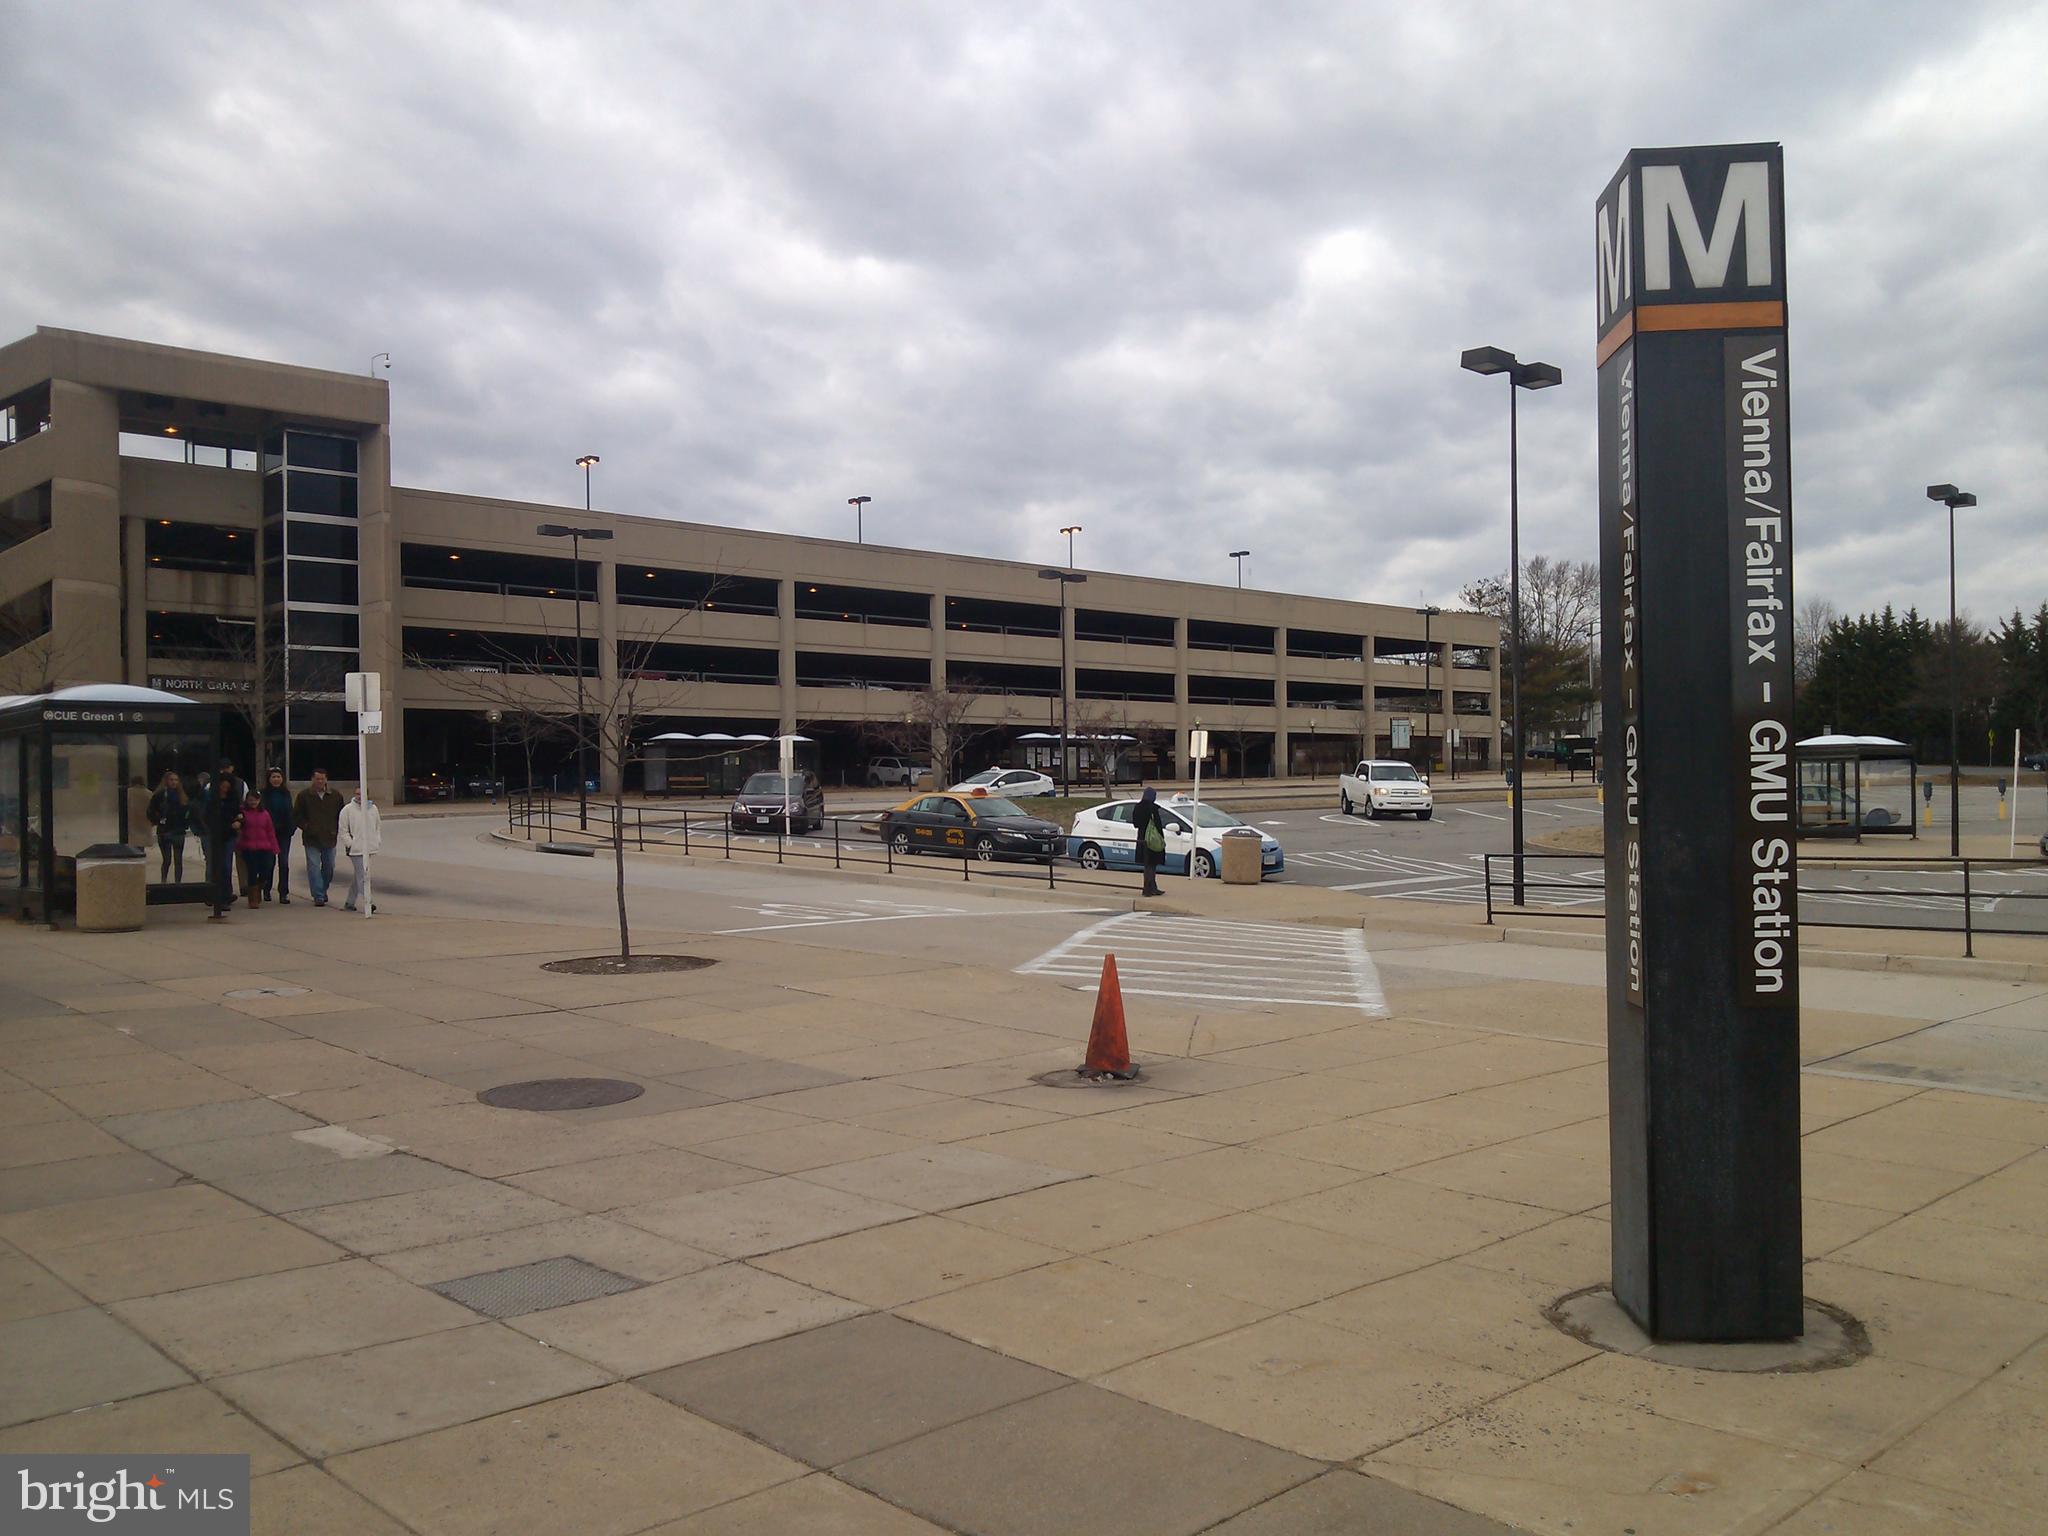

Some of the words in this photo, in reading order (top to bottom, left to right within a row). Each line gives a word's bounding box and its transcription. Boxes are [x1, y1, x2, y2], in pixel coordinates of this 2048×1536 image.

[1598, 173, 1631, 328] M
[1641, 161, 1772, 291] M
[1620, 358, 1635, 672] Vienna/Fairfax
[1741, 348, 1784, 665] Vienna/Fairfax
[54, 711, 78, 721] CUE
[81, 711, 115, 721] Green
[165, 679, 203, 689] NORTH
[206, 681, 250, 691] GARAE
[1626, 724, 1639, 826] GMU
[1749, 719, 1788, 822] GMU
[1627, 840, 1641, 992] Station
[1751, 838, 1790, 993] Station
